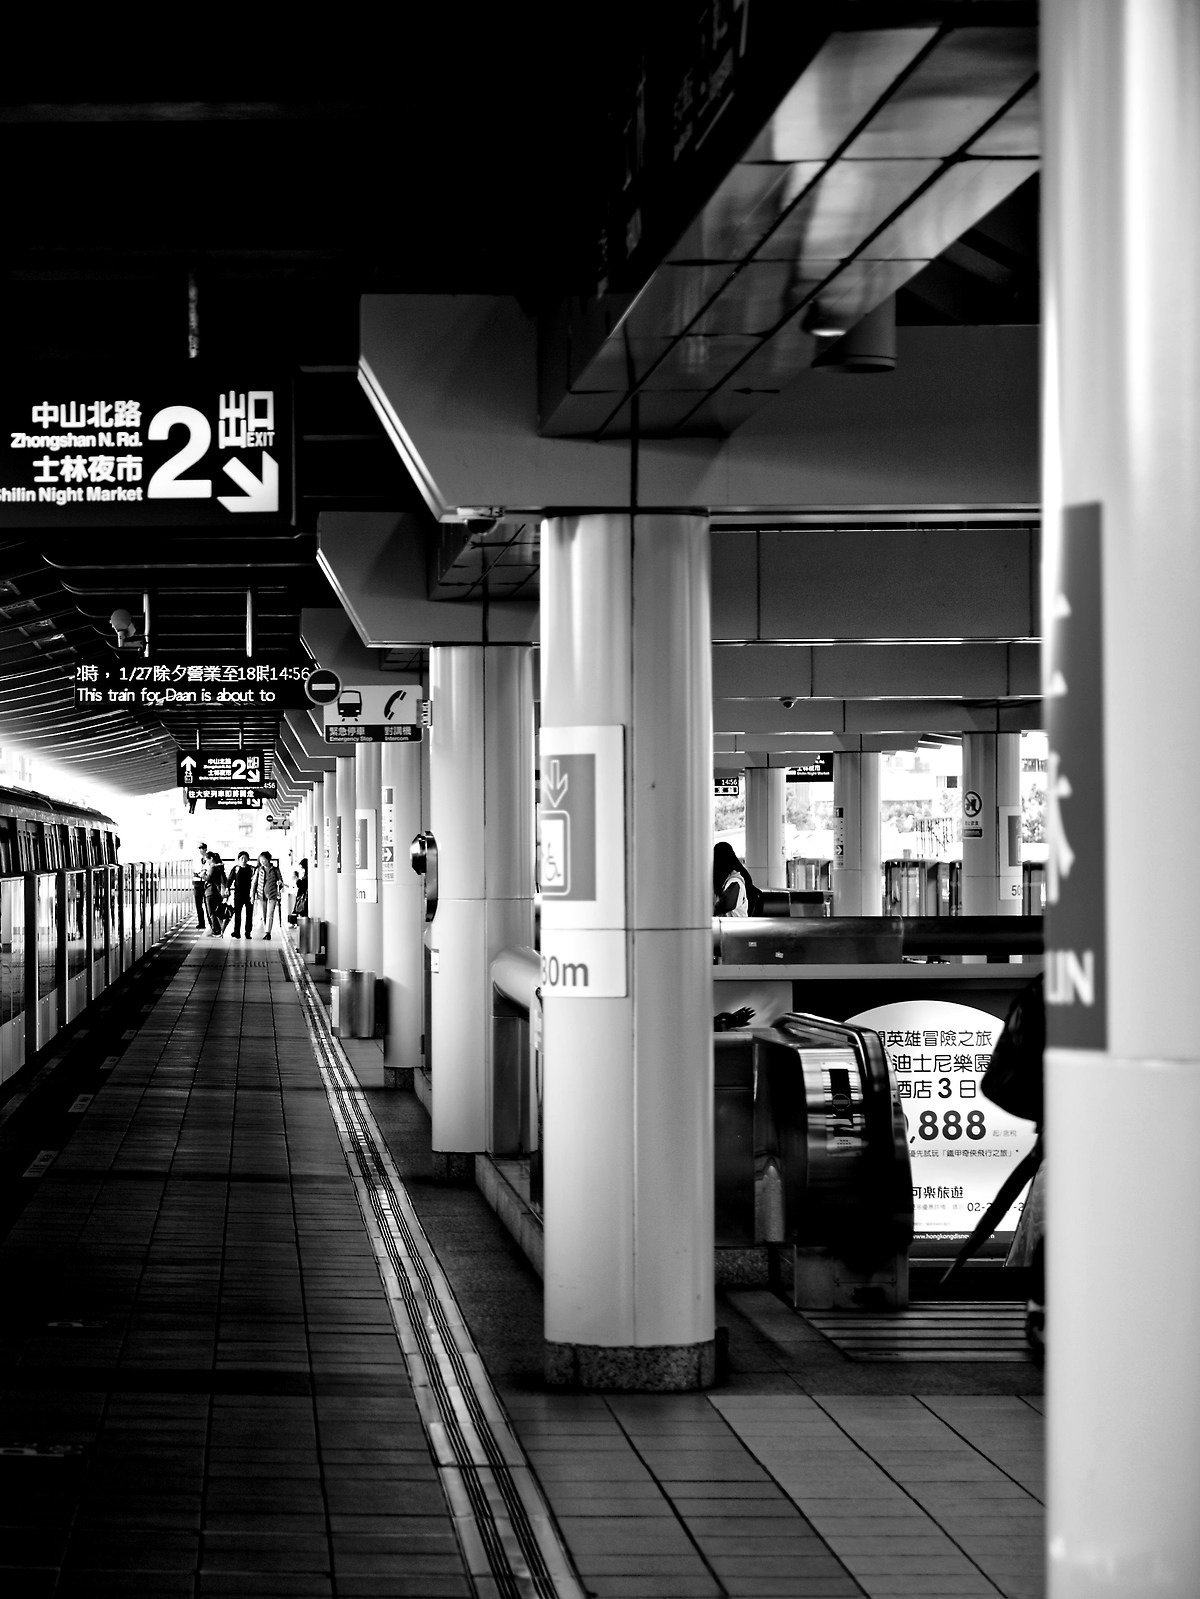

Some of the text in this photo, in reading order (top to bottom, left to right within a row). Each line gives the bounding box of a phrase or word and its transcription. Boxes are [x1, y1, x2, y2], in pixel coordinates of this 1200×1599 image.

[31, 400, 142, 429] 中山北路
[218, 390, 274, 449] 出口
[10, 432, 144, 451] Zhongshan N. Rd.
[247, 431, 275, 447] EXIT
[147, 405, 212, 499] 2
[32, 454, 144, 483] 士林夜市
[38, 487, 84, 506] Night
[86, 486, 144, 502] Market
[77, 687, 276, 702] This train for Daan is about to
[231, 758, 247, 780] 2
[892, 1054, 992, 1073] 迪士尼樂園
